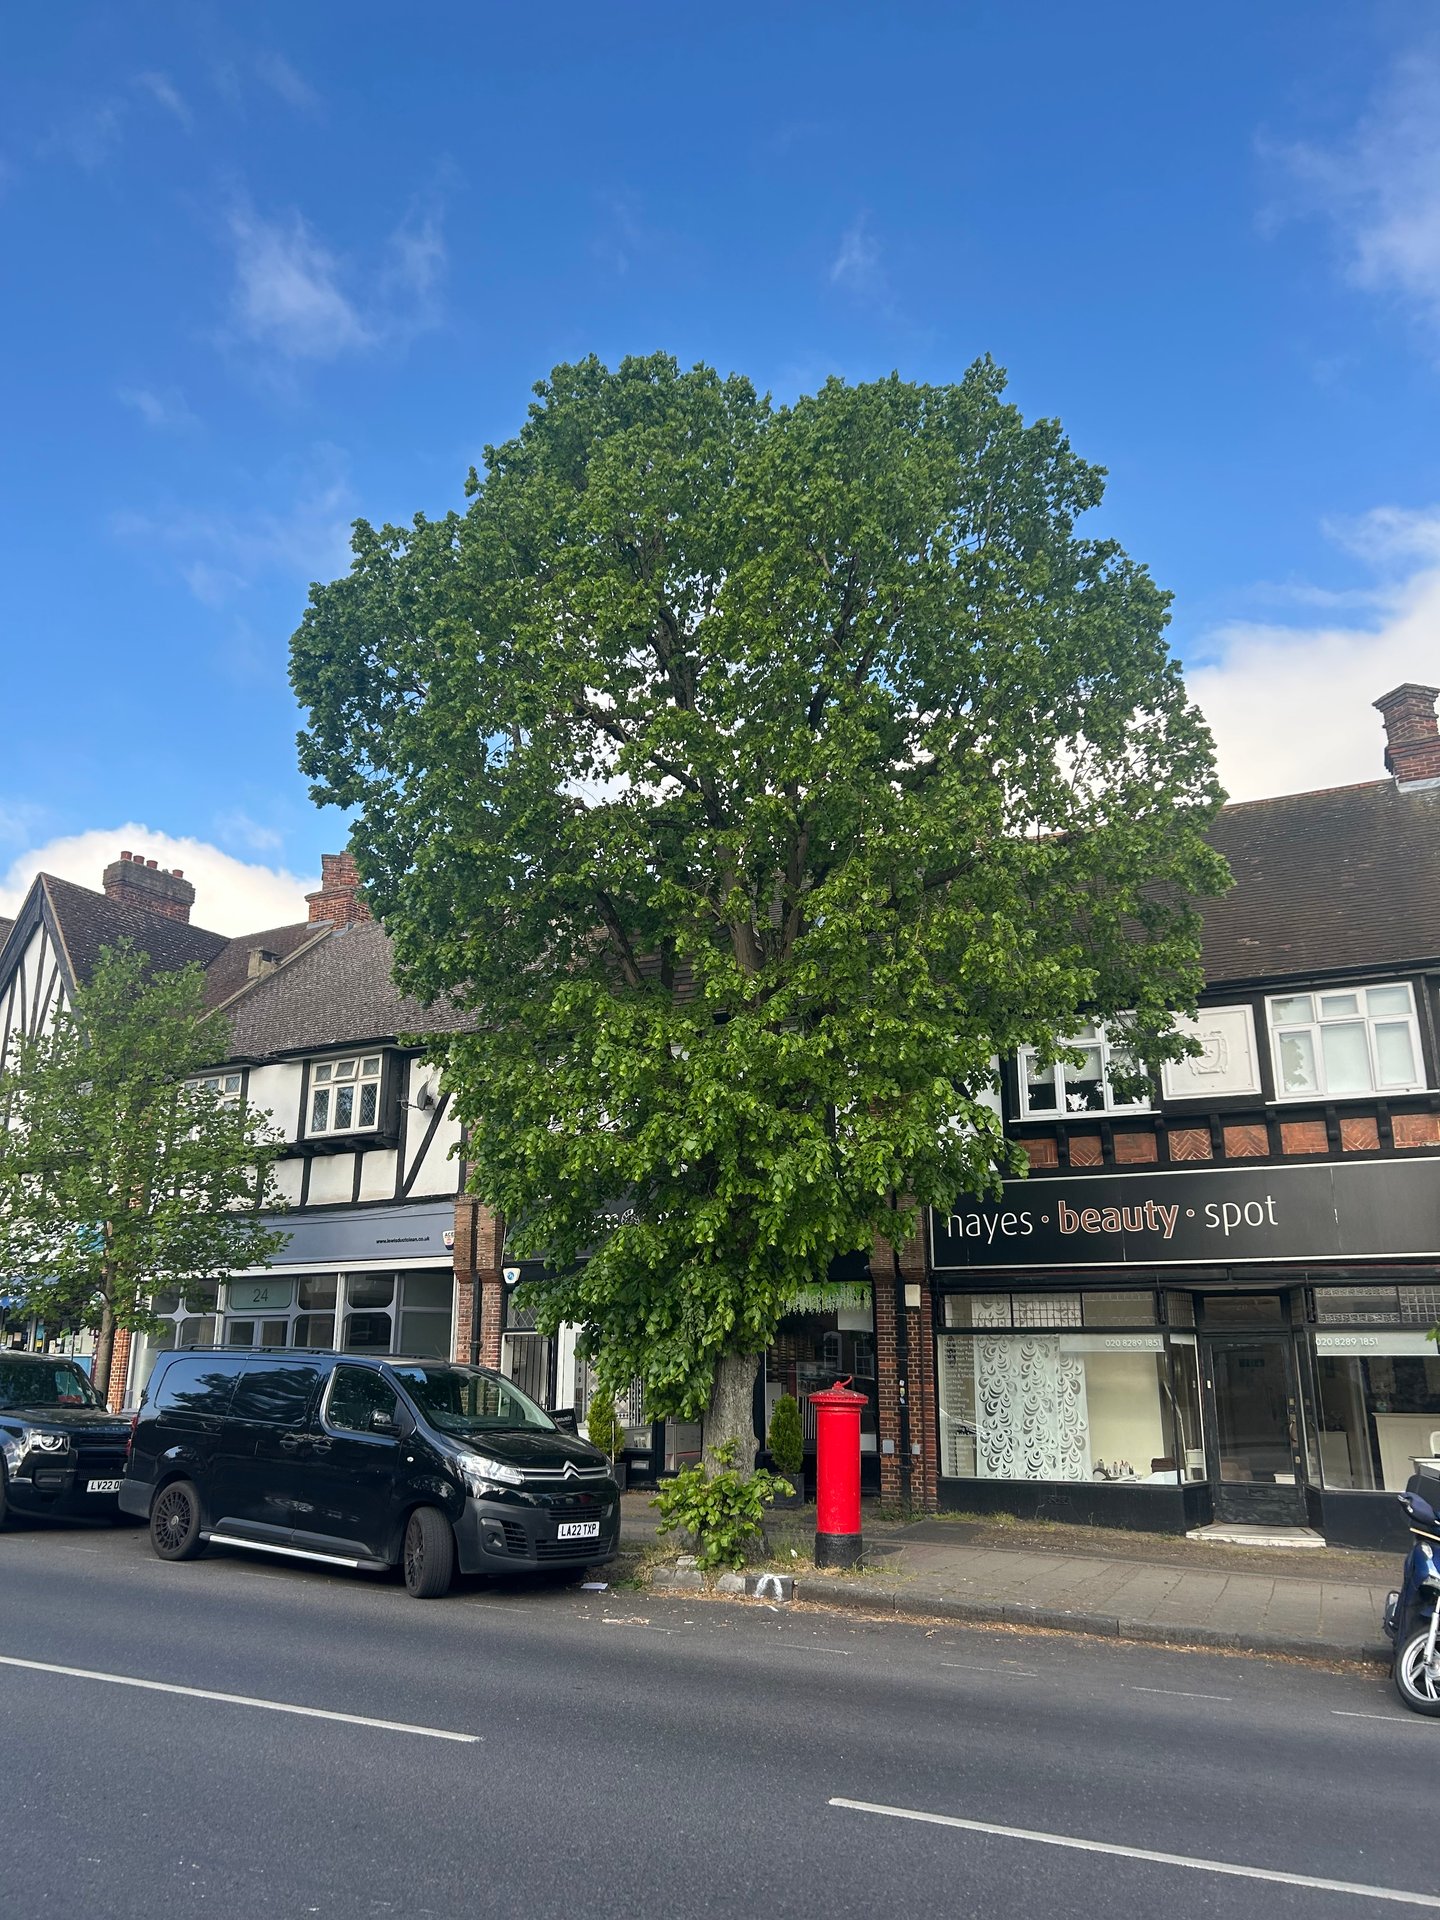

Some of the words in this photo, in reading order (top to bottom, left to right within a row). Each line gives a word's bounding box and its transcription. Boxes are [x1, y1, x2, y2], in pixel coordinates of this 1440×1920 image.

[1057, 1199, 1179, 1239] beauty
[1204, 1195, 1279, 1236] spot
[252, 1288, 268, 1302] 24
[1105, 1339, 1121, 1347] 020
[1122, 1339, 1143, 1347] 8289
[1145, 1339, 1162, 1347] 1851
[1315, 1337, 1333, 1346] 020
[1334, 1337, 1357, 1346] 8289
[1360, 1337, 1379, 1346] 1851
[91, 1481, 113, 1490] LV22
[561, 1524, 582, 1537] LA22
[583, 1523, 597, 1535] TXP
